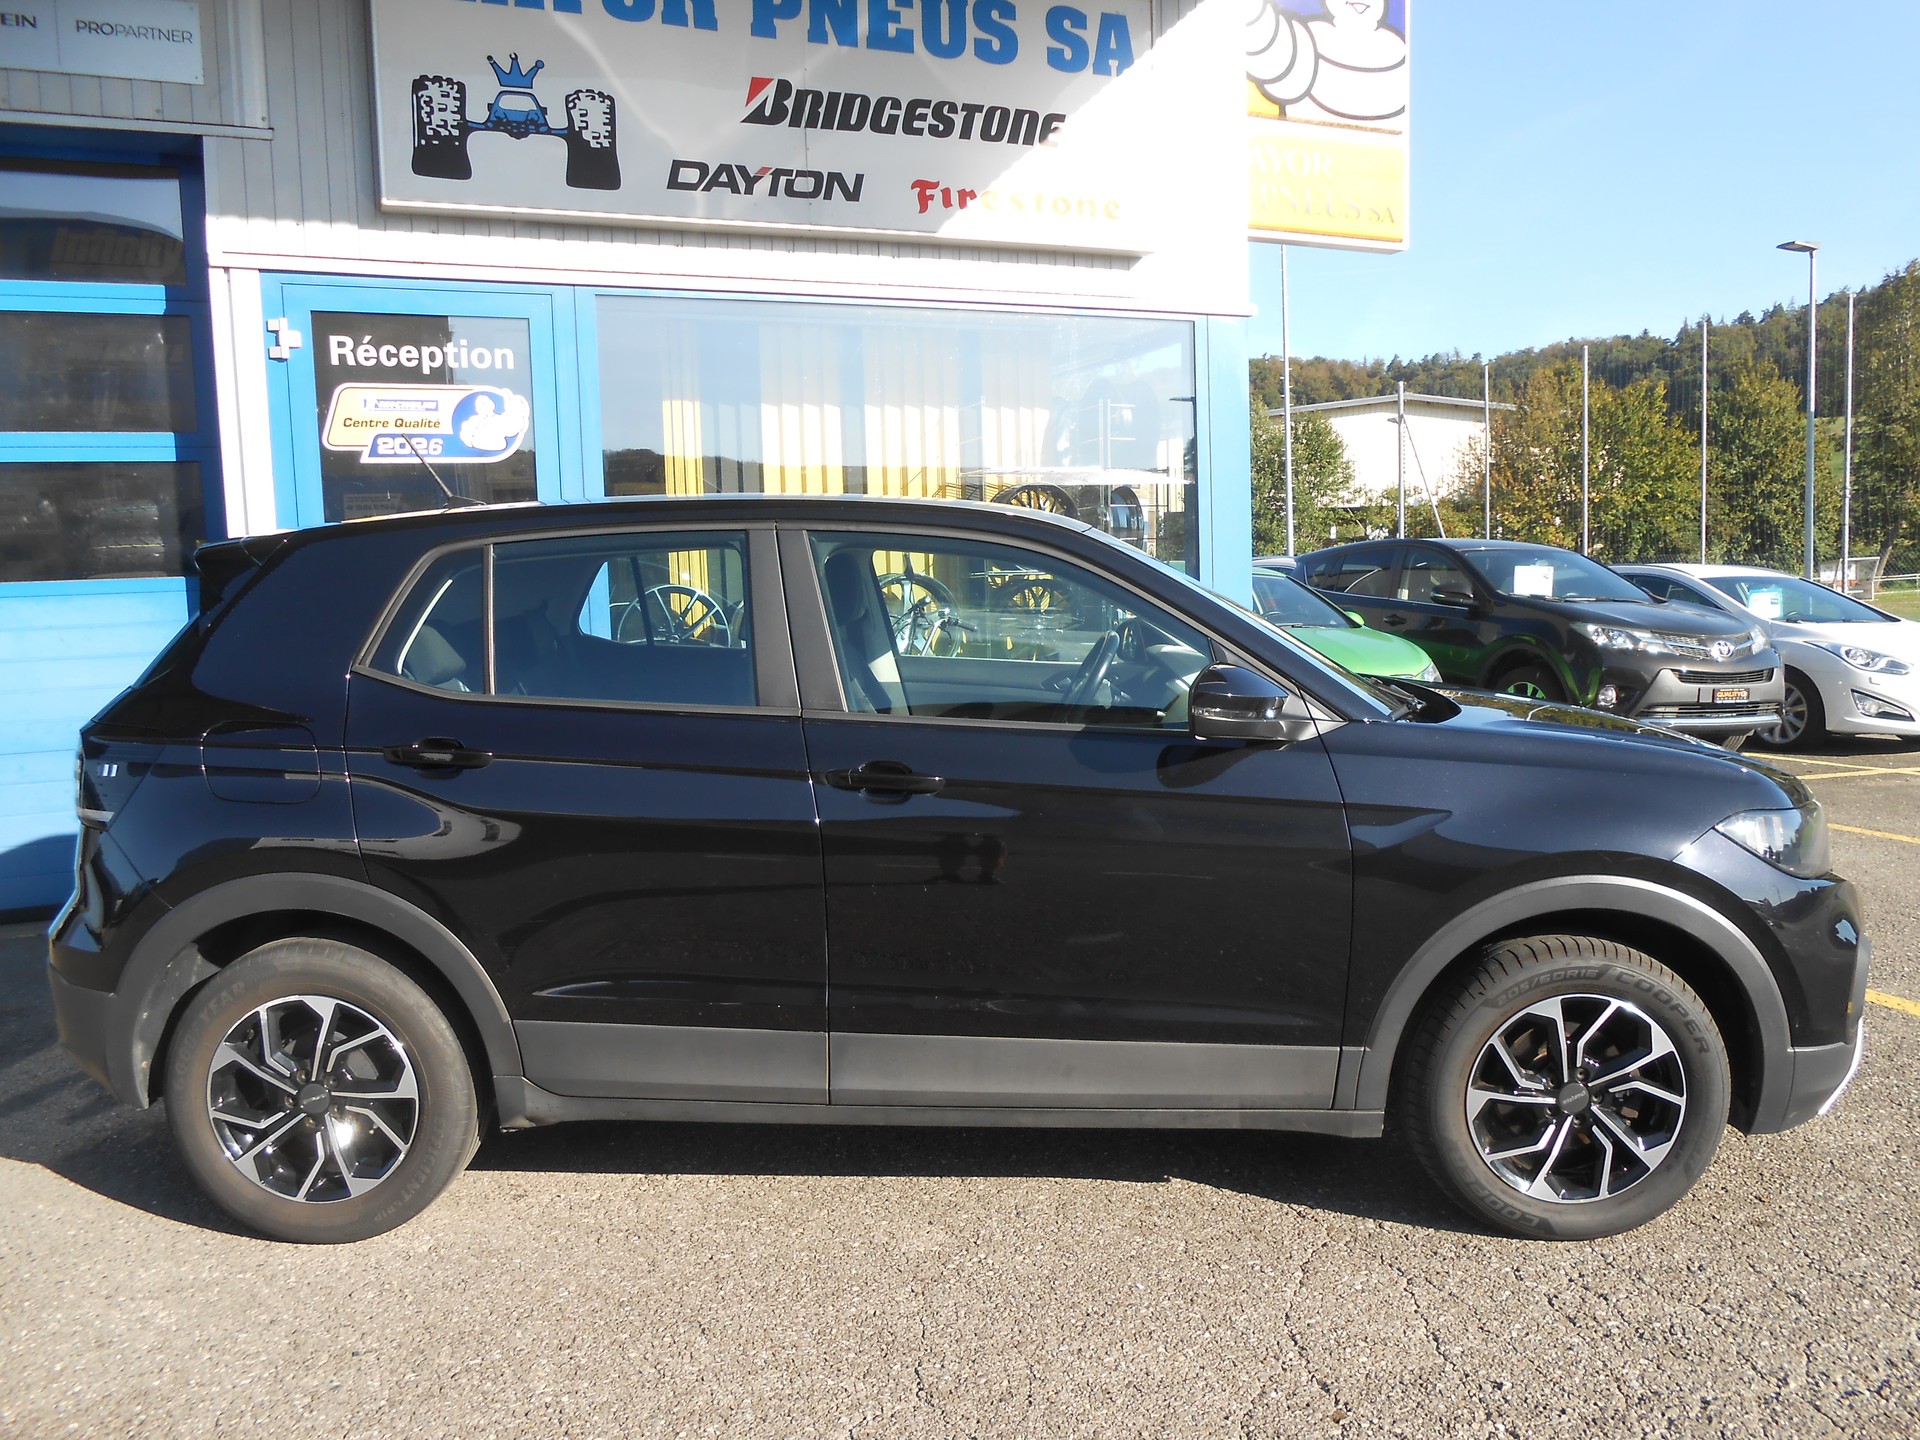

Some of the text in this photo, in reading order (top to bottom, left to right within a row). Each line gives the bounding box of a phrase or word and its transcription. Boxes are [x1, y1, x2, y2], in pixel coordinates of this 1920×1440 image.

[75, 19, 193, 44] PROPARTNER
[750, 0, 1019, 65] PNEUS
[1045, 5, 1135, 77] SA
[740, 76, 1067, 148] BRIDGESTONE
[666, 159, 865, 203] DAYTON
[910, 178, 1121, 221] Firestone
[328, 334, 515, 375] Réception
[343, 416, 441, 430] Centre Qualité
[376, 436, 444, 455] 2026
[1612, 968, 1712, 1056] COOPER
